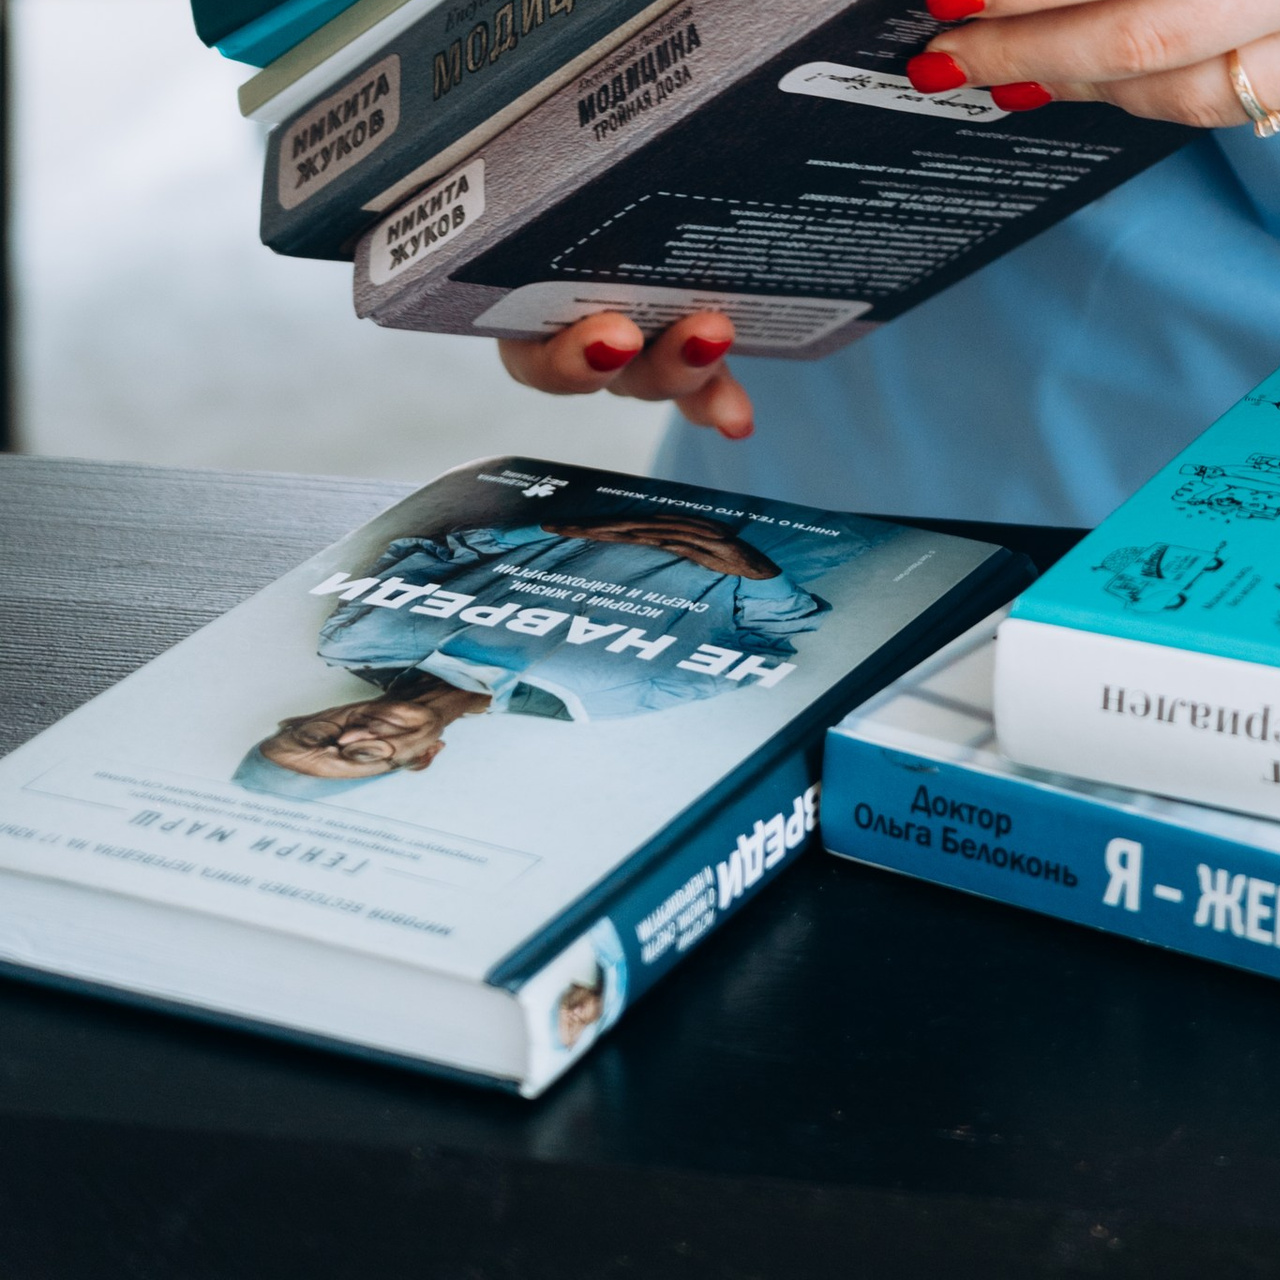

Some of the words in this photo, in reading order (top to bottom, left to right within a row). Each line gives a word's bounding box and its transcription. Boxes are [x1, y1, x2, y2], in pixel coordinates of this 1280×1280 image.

[578, 23, 700, 127] МОДИЦИНА
[293, 73, 390, 159] НИКИТА
[593, 89, 652, 141] ТРОЙНАЯ
[657, 65, 692, 106] ДОЗА
[295, 109, 385, 189] ЖУКОВ
[387, 175, 469, 245] НИКИТА
[390, 204, 466, 269] ЖУКОВ
[596, 486, 649, 500] ЖИЗНИ
[649, 495, 712, 511] СПАСАЕТ
[716, 507, 744, 518] КТО
[749, 512, 776, 524] ТЕХ,
[793, 522, 841, 537] КНИГИ
[493, 564, 627, 594] НЕЙРОХИРУРГИИ
[626, 588, 638, 597] И
[571, 593, 583, 602] О
[587, 595, 663, 618] ИСТОРИИ
[643, 590, 709, 613] СМЕРТИ
[309, 571, 677, 662] НАВРЕДИ
[676, 643, 797, 688] НЕ
[129, 809, 237, 842] МАРШ
[911, 785, 1012, 838] Доктор
[66, 837, 90, 850] НА
[93, 843, 197, 873] ПЕРЕВЕДЕНА
[250, 835, 370, 874] ГЕНРИ
[854, 802, 932, 847] Ольга
[941, 826, 1078, 888] Белоконь
[1103, 837, 1143, 913] Я
[368, 907, 454, 935] МИРОВОЙ
